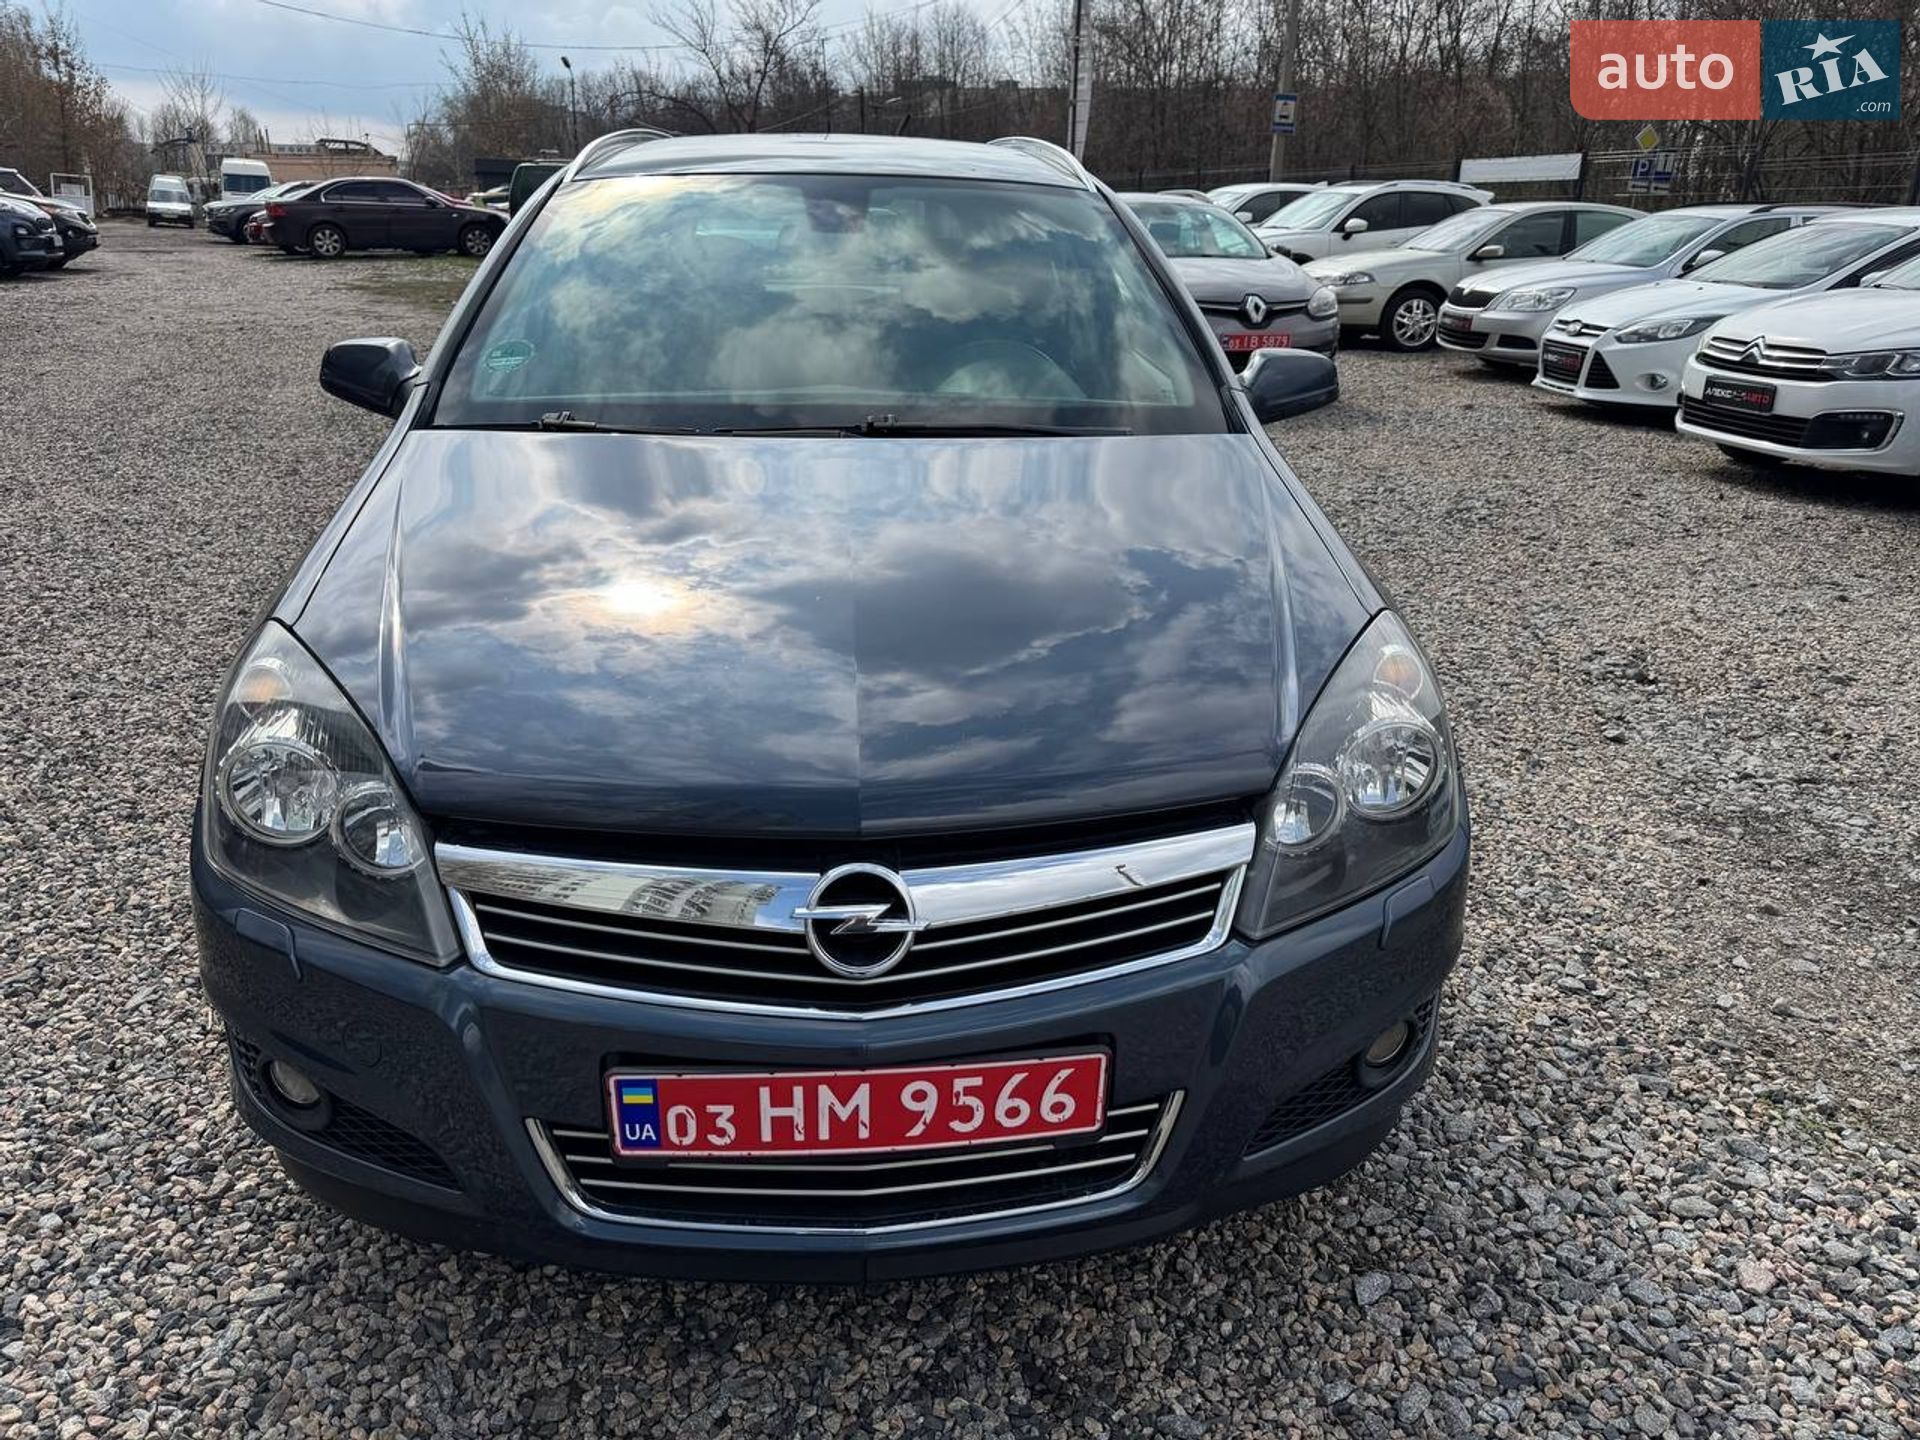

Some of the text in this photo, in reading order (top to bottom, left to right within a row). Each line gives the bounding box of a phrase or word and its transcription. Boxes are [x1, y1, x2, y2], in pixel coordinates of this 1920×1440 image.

[666, 1068, 1076, 1146] 03 HM 9566
[625, 1123, 657, 1141] UA
